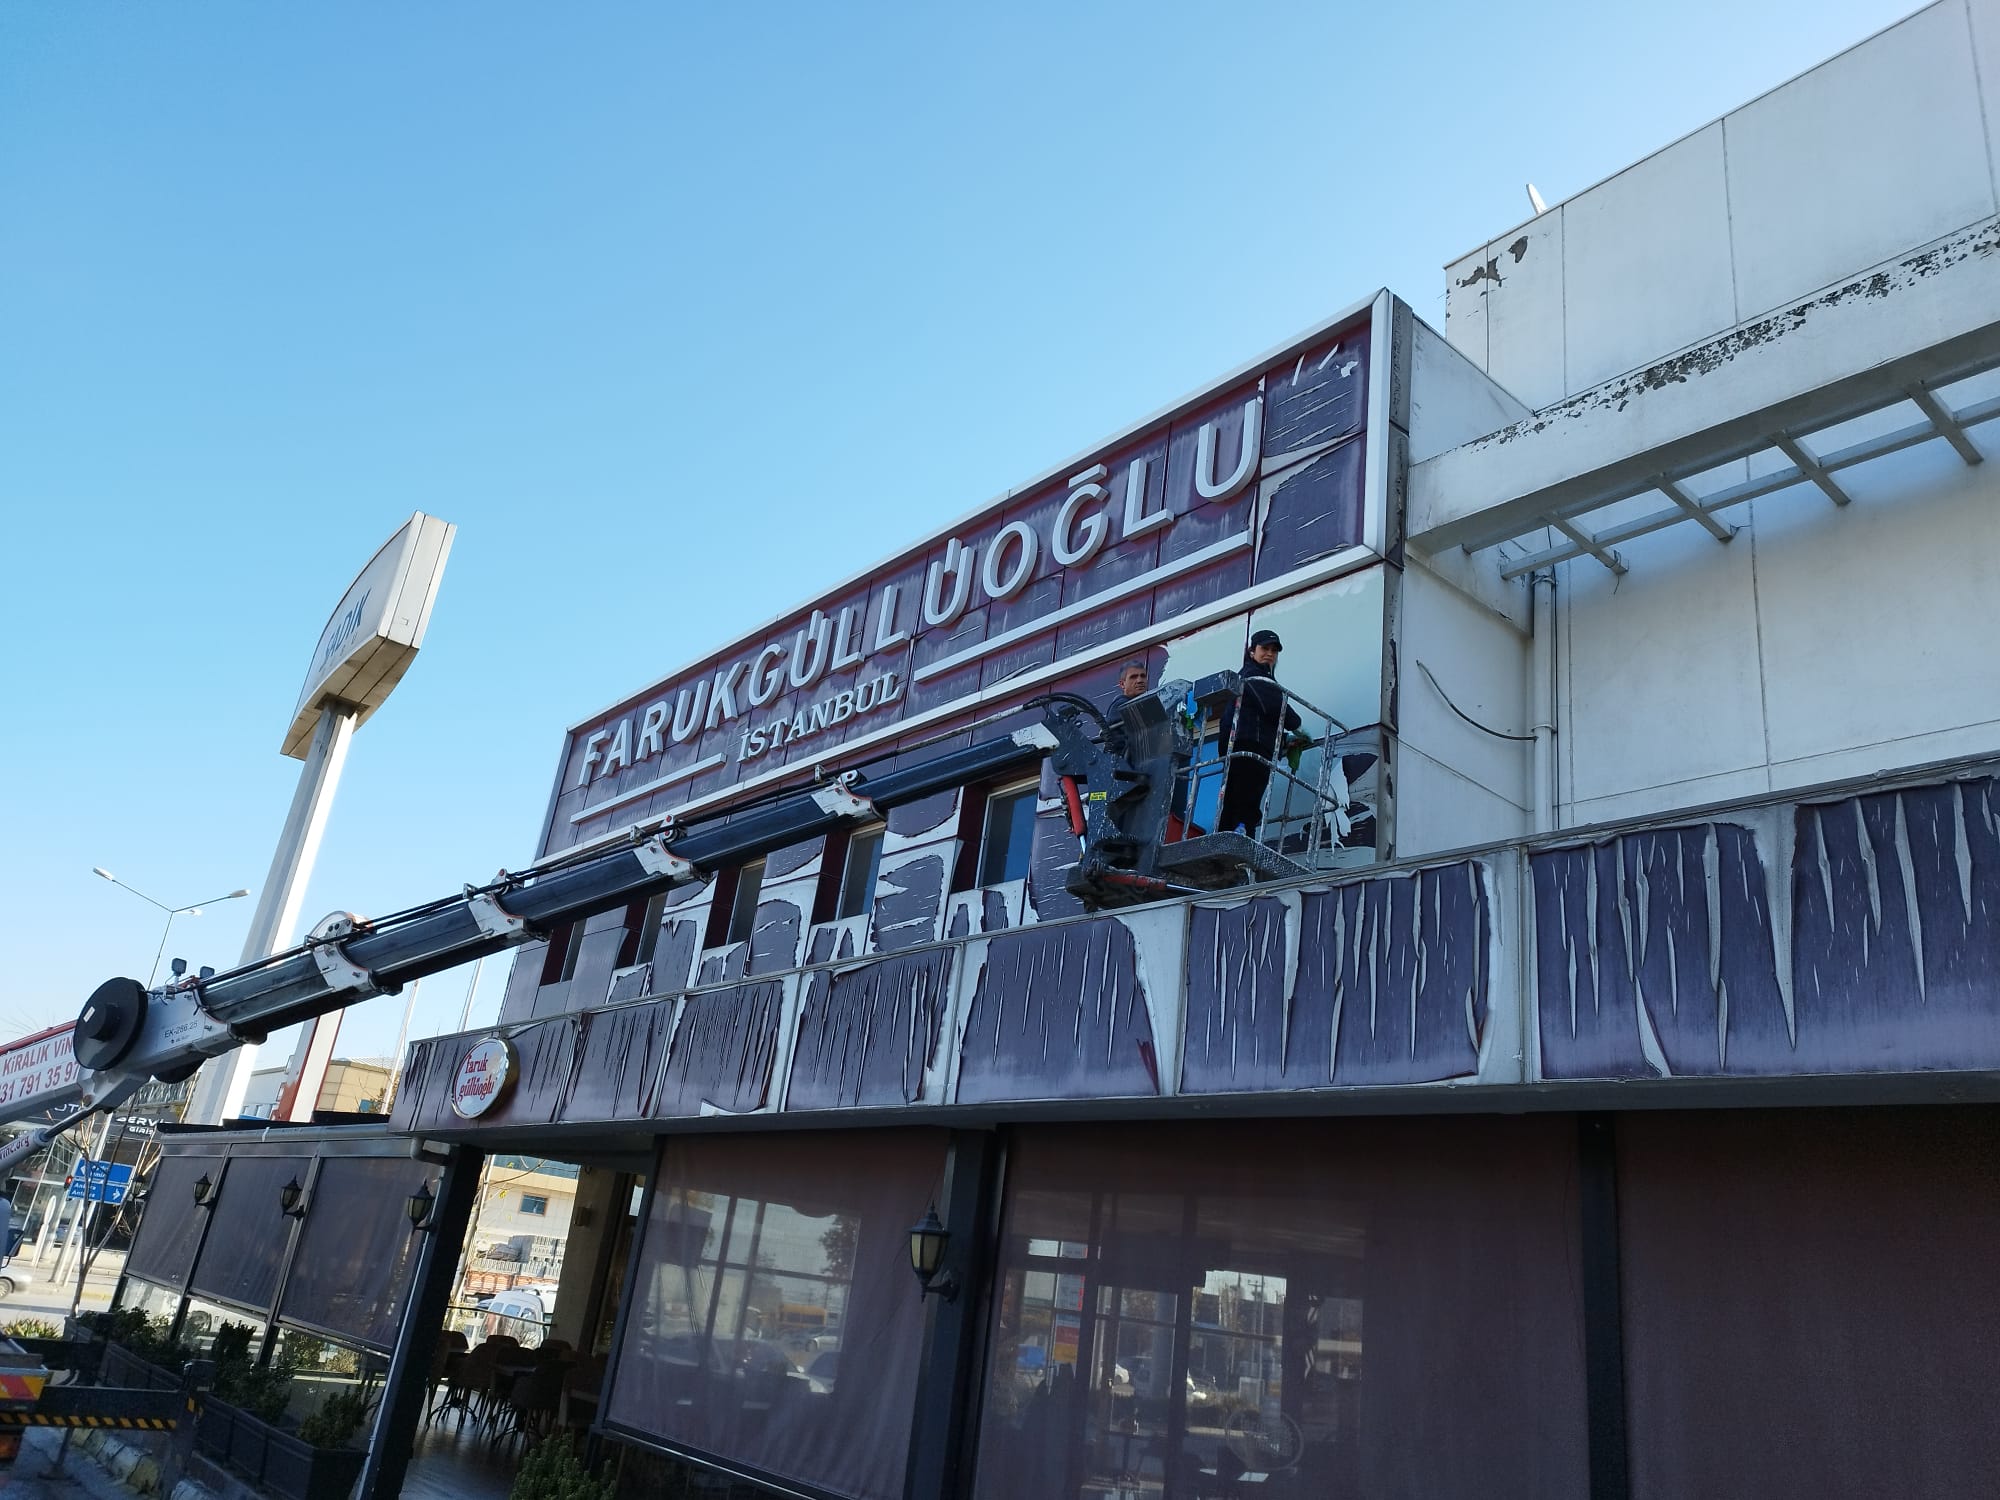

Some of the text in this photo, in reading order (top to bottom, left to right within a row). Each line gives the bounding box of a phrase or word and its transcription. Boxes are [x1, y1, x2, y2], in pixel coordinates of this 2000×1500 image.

[737, 671, 905, 763] İSTANBUL
[0, 1061, 79, 1103] 31 791 35 97
